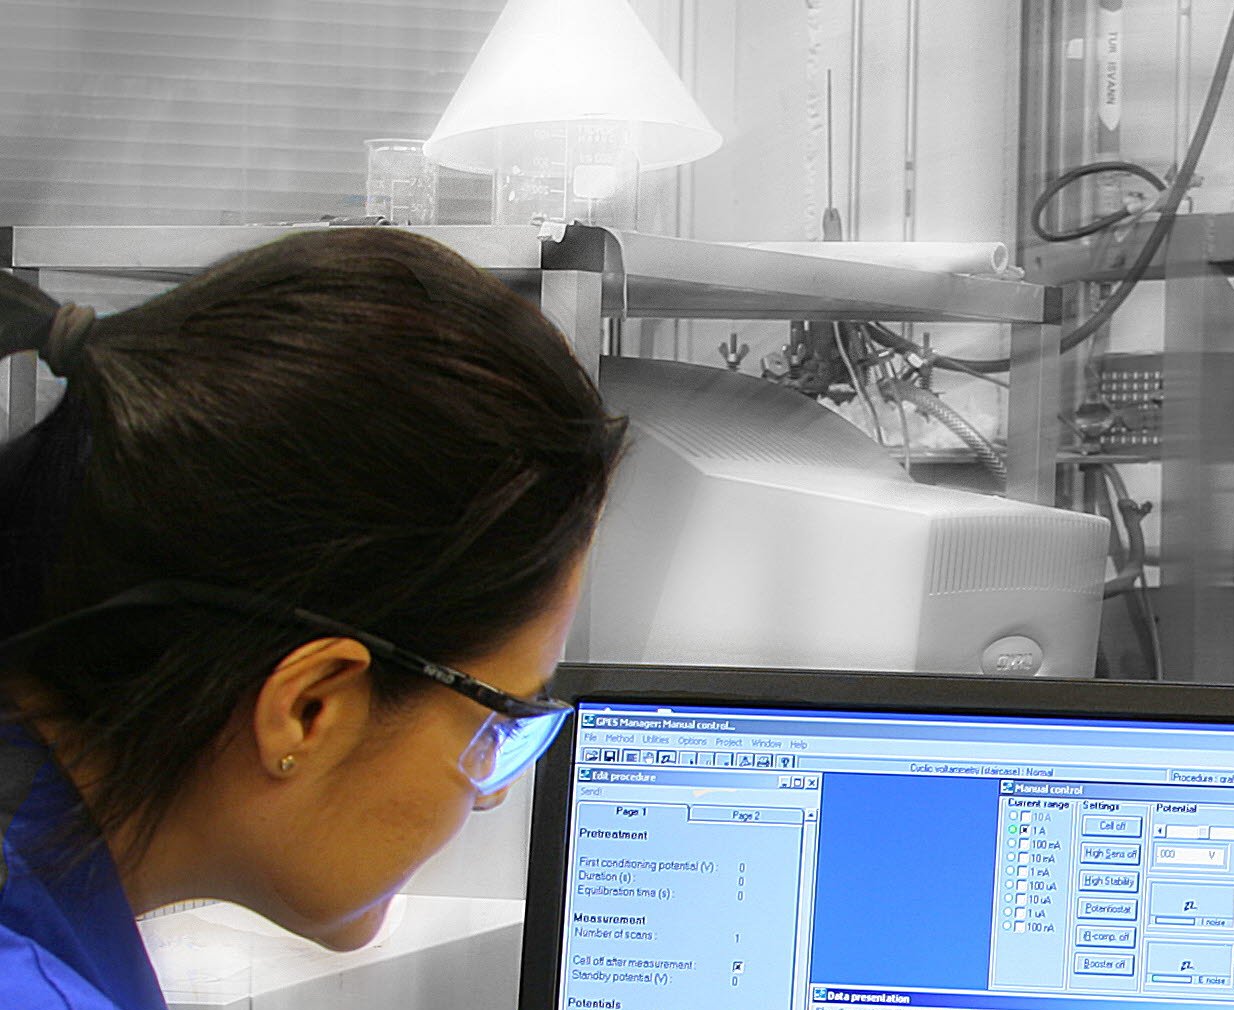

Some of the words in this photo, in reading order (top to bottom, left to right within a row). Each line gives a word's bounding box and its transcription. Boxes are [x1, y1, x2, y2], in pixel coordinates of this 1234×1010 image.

[663, 720, 696, 729] Manual
[584, 734, 598, 742] File
[605, 734, 635, 743] Method
[642, 735, 670, 745] Utilities
[678, 737, 707, 747] Options
[716, 738, 743, 748] Project
[752, 739, 782, 748] Window
[790, 740, 808, 750] Help
[910, 763, 934, 774] Cyclic
[1025, 768, 1054, 777] Normal
[610, 774, 657, 784] procedure
[1015, 785, 1049, 795] Manual
[1049, 786, 1084, 795] control
[1008, 798, 1041, 808] Current
[1043, 801, 1070, 811] range
[1083, 800, 1120, 811] Settings
[1156, 803, 1198, 813] Potential
[617, 807, 639, 818] Page
[732, 810, 752, 821] Page
[1099, 821, 1114, 831] Cell
[579, 828, 648, 841] Pretreatment
[1032, 839, 1047, 849] 100
[1031, 853, 1042, 863] 10
[1085, 850, 1103, 860] High
[580, 857, 600, 868] First
[601, 859, 657, 872] conditioning
[658, 862, 699, 873] potential
[578, 871, 617, 882] Duration
[1084, 876, 1103, 887] High
[1104, 877, 1135, 888] Stability
[1029, 881, 1044, 890] 100
[577, 885, 635, 898] Equilibration
[636, 888, 656, 898] time
[1028, 894, 1039, 904] 10
[1085, 903, 1132, 914] Potentiostat
[574, 913, 646, 925] Measurement
[1027, 922, 1042, 932] 100
[574, 928, 612, 939] Number
[572, 955, 591, 966] Cell
[1083, 959, 1113, 969] Booster
[572, 969, 611, 982] Standby
[612, 971, 653, 983] potential
[568, 997, 621, 1009] Potentials
[828, 992, 849, 1003] Data
[850, 993, 911, 1006] presentation
